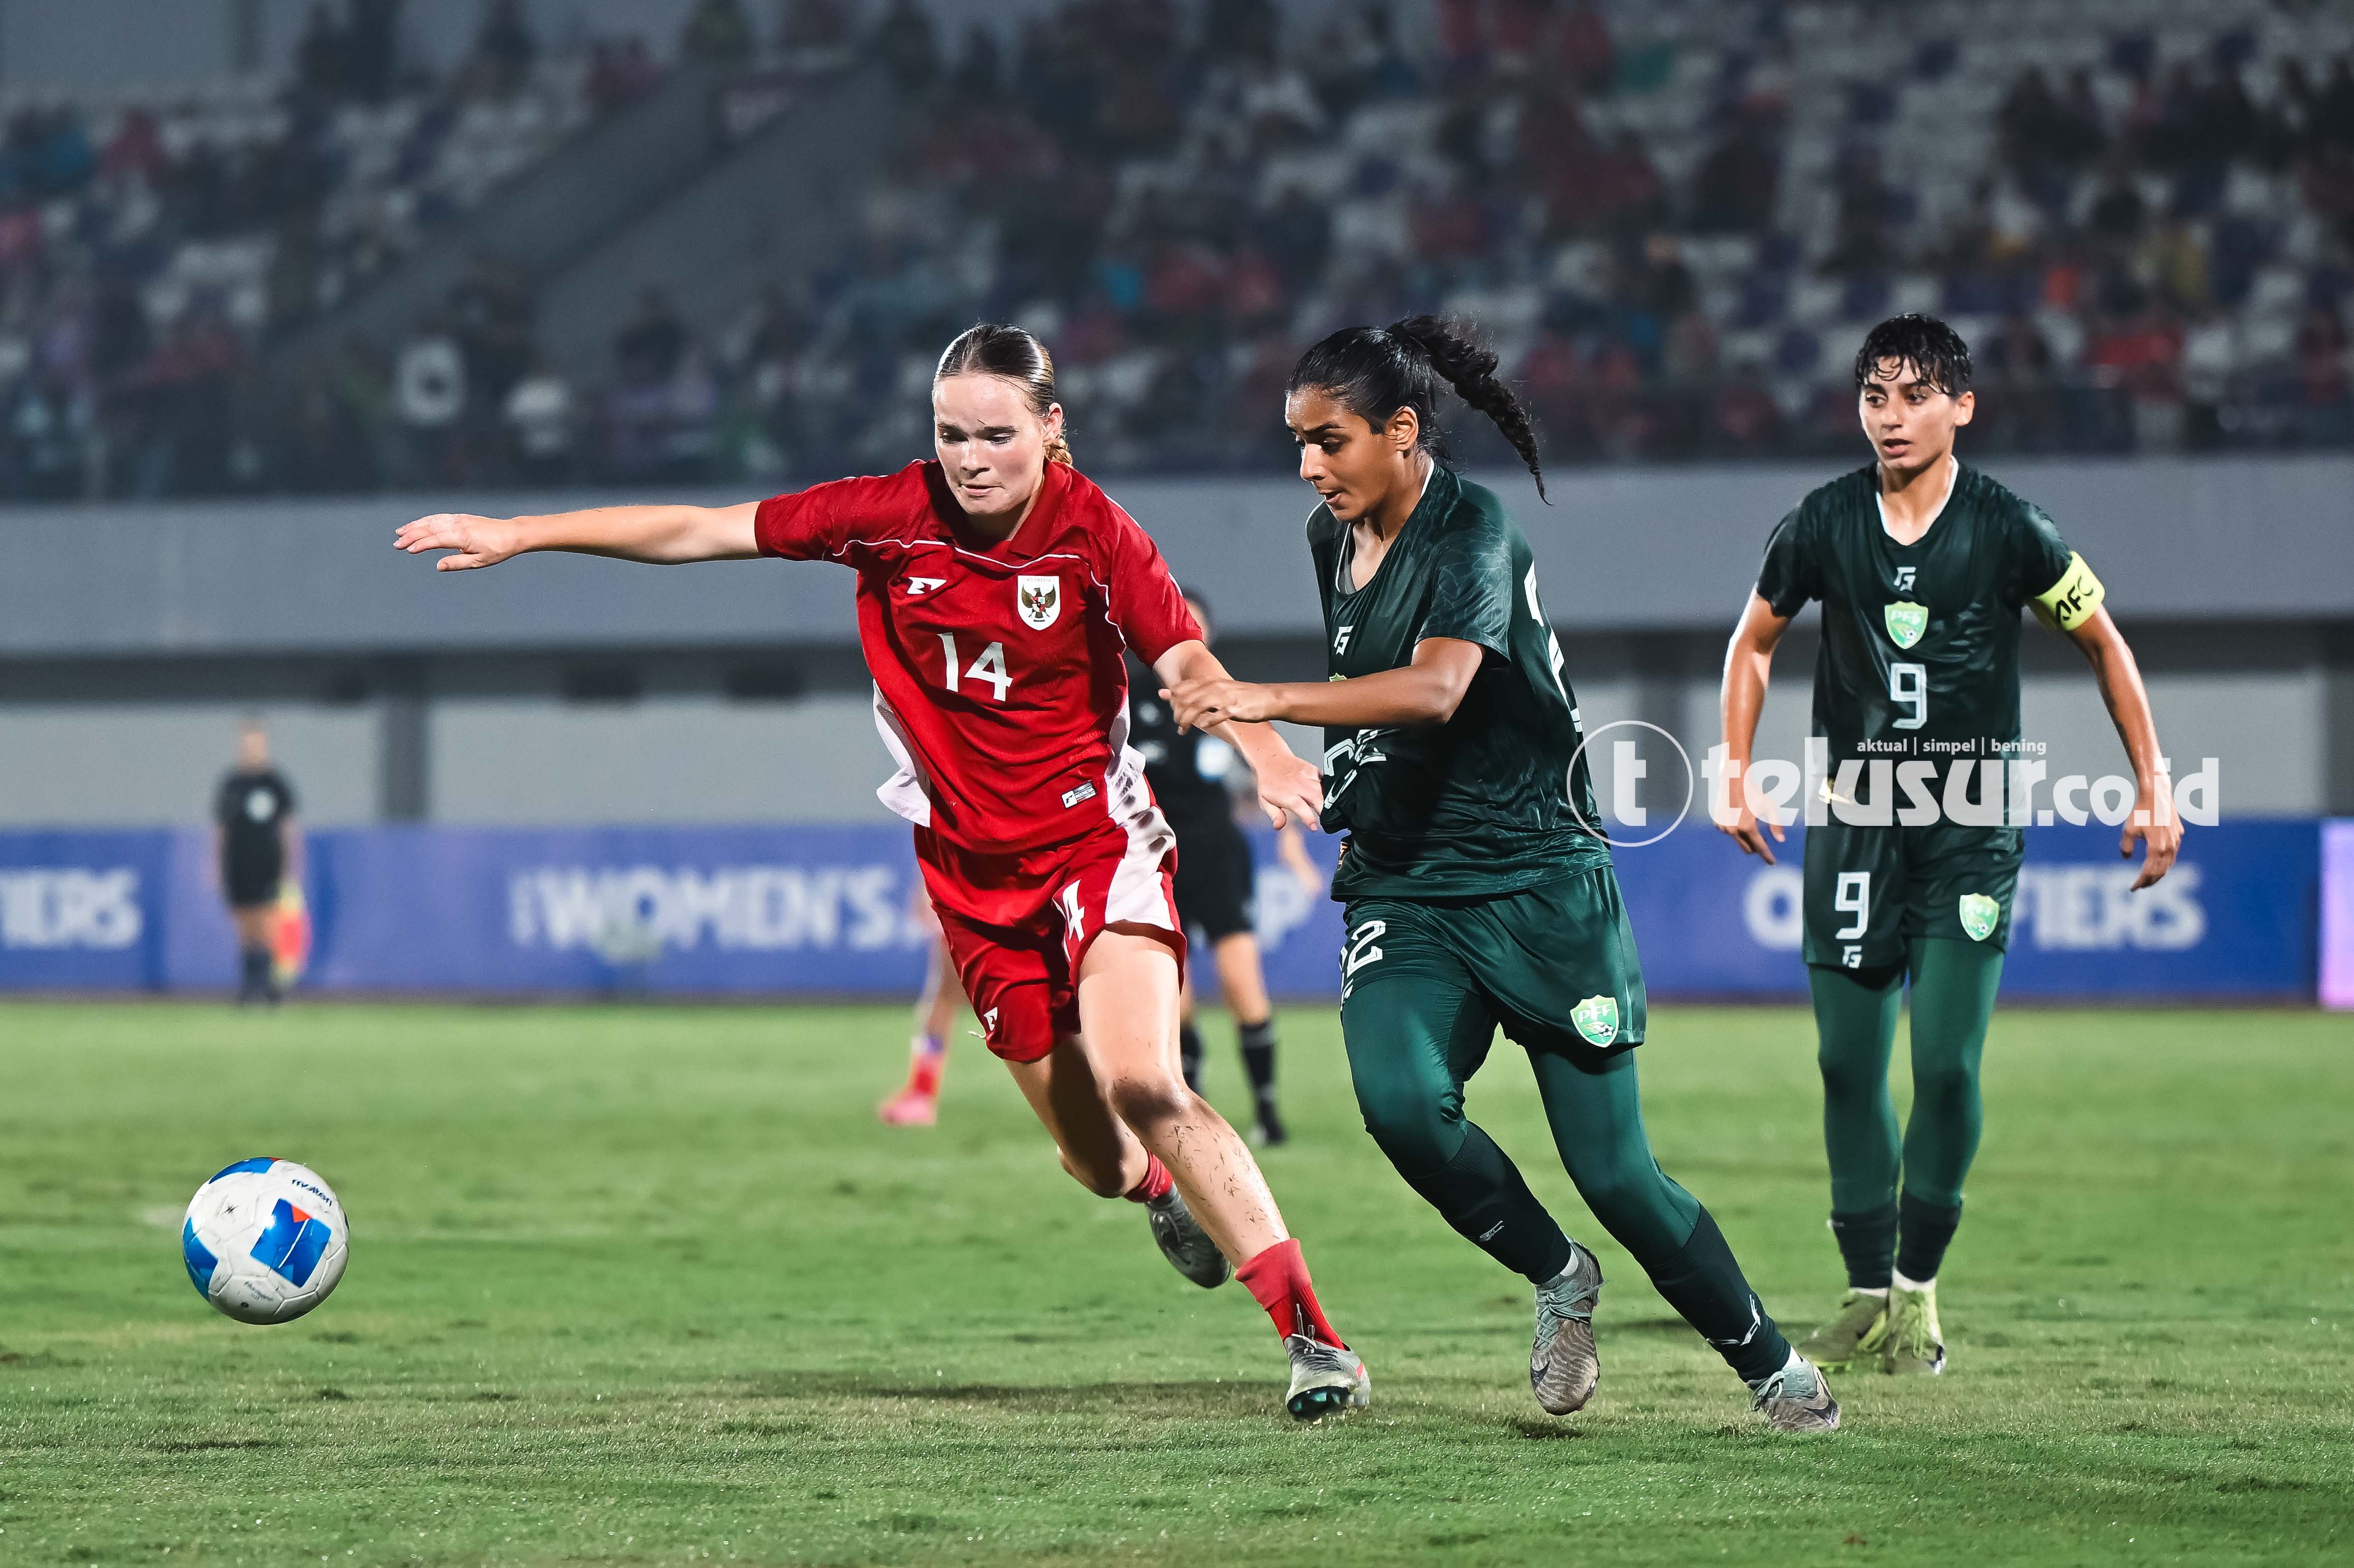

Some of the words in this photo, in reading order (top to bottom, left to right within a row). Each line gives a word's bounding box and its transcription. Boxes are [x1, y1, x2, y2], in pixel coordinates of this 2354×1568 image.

[2056, 573, 2094, 624] AFC
[937, 632, 1014, 701] 14
[1890, 662, 1927, 729] 9
[1835, 872, 1870, 939] 9
[1578, 1003, 1612, 1023] PFF
